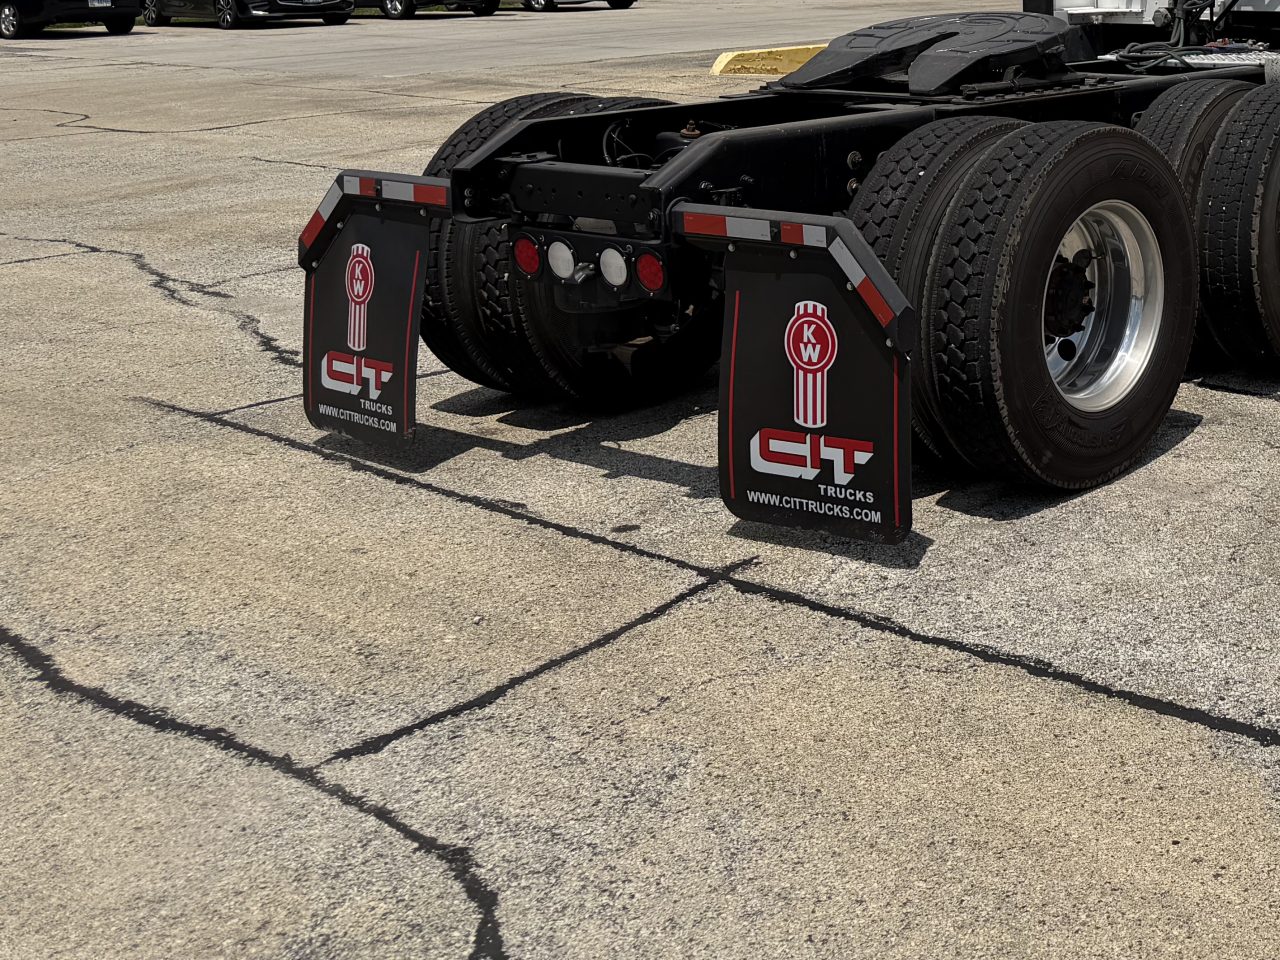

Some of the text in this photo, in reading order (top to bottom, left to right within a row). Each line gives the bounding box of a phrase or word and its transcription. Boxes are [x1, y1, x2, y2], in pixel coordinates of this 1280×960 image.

[321, 350, 393, 399] CIT
[318, 403, 397, 433] WWW.CITTRUCKS.COM
[359, 398, 393, 416] TRUCKS
[749, 427, 875, 485] CIT
[747, 490, 882, 524] WWW.CITTRUCKS.COM
[818, 485, 875, 504] TRUCKS
